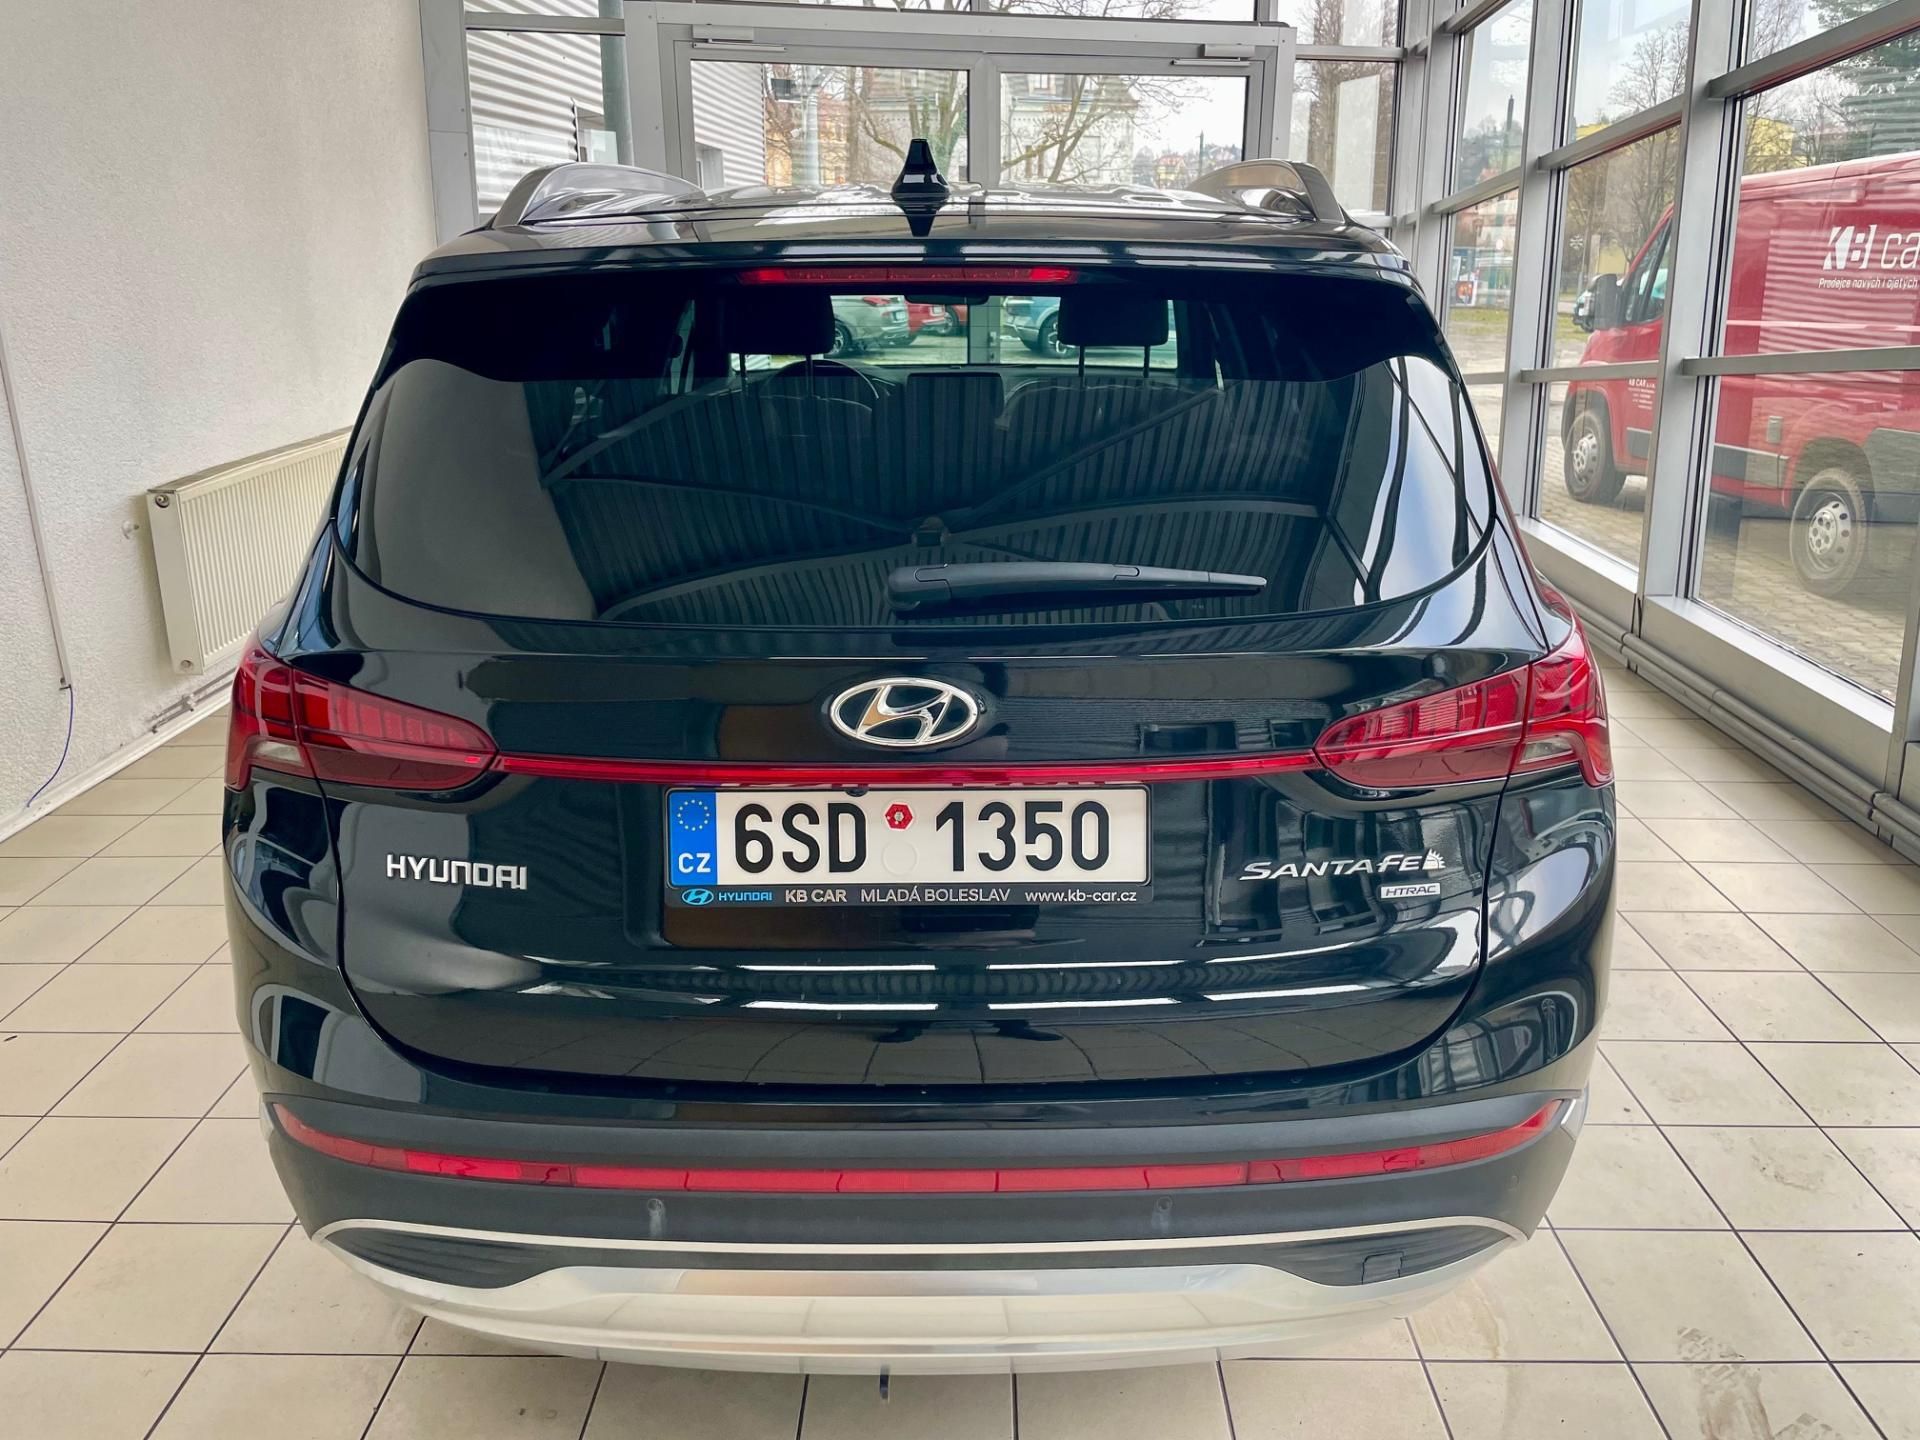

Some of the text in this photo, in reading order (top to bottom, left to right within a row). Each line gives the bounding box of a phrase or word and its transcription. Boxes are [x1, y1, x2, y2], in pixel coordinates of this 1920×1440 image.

[1818, 277, 1851, 290] Prodejce
[734, 800, 1111, 874] 6SD 1350
[386, 854, 528, 890] HYUNDAI
[678, 852, 711, 873] CZ
[718, 886, 1137, 903] HYUNDAI KB CAR MLADÁ BOLESLAV www.kb-car.cz
[1385, 884, 1437, 897] HTRAC
